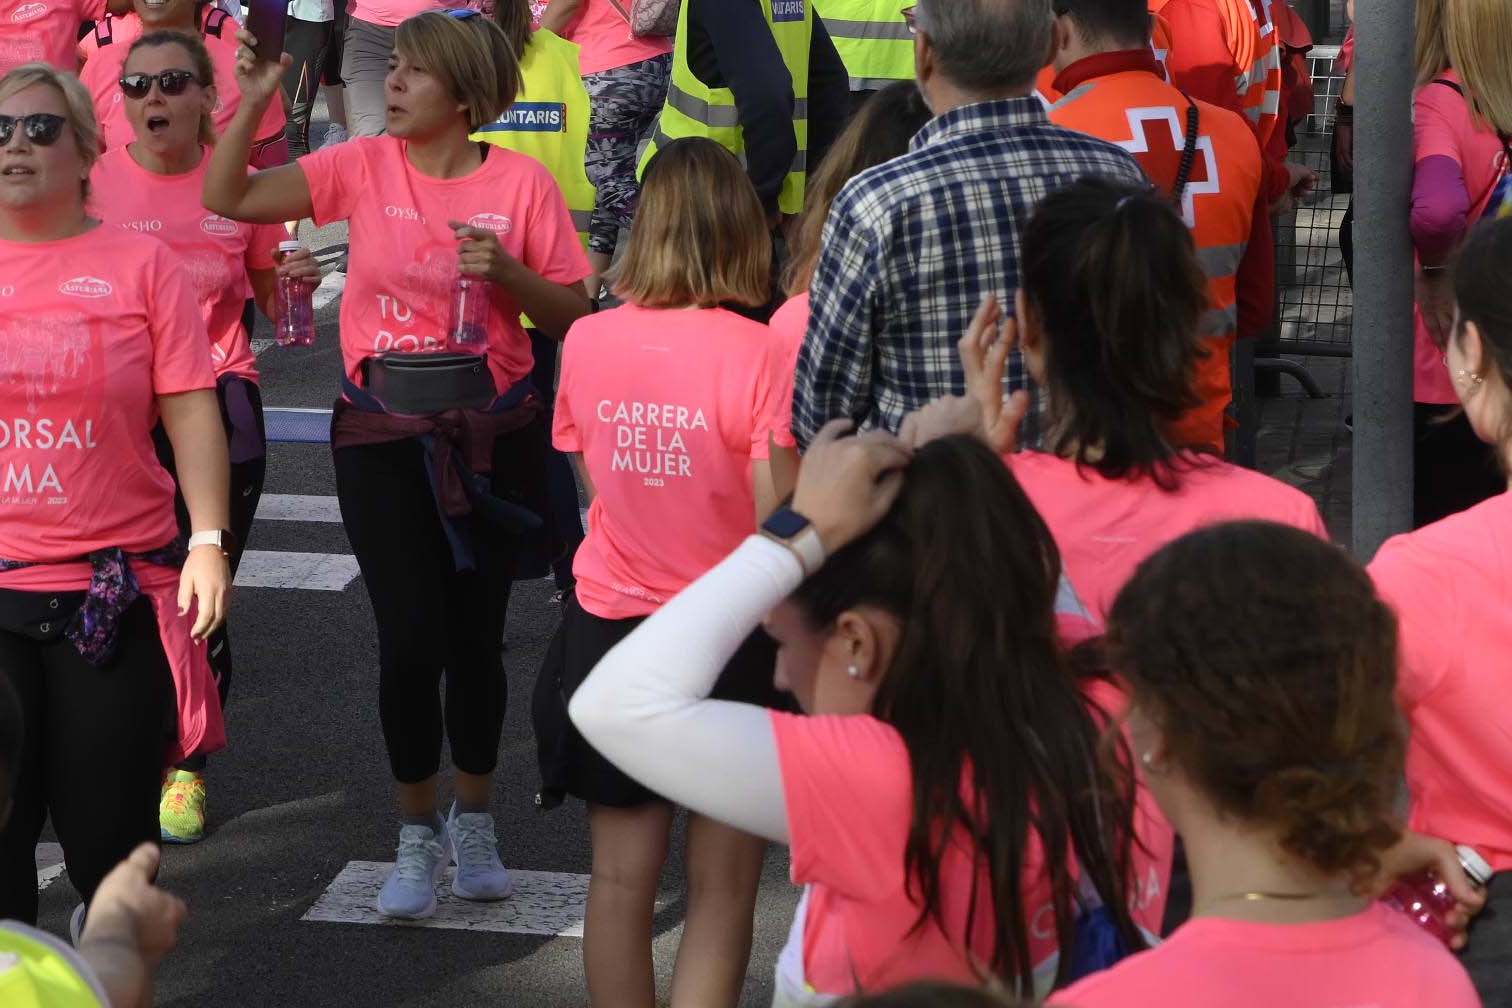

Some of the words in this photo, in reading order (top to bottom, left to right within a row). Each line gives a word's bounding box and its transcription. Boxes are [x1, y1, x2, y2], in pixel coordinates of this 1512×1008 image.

[376, 293, 413, 323] TU
[597, 399, 709, 432] CARRERA
[617, 426, 647, 449] DE
[657, 431, 688, 453] LA
[611, 450, 692, 477] MUJER
[644, 478, 665, 487] 2023
